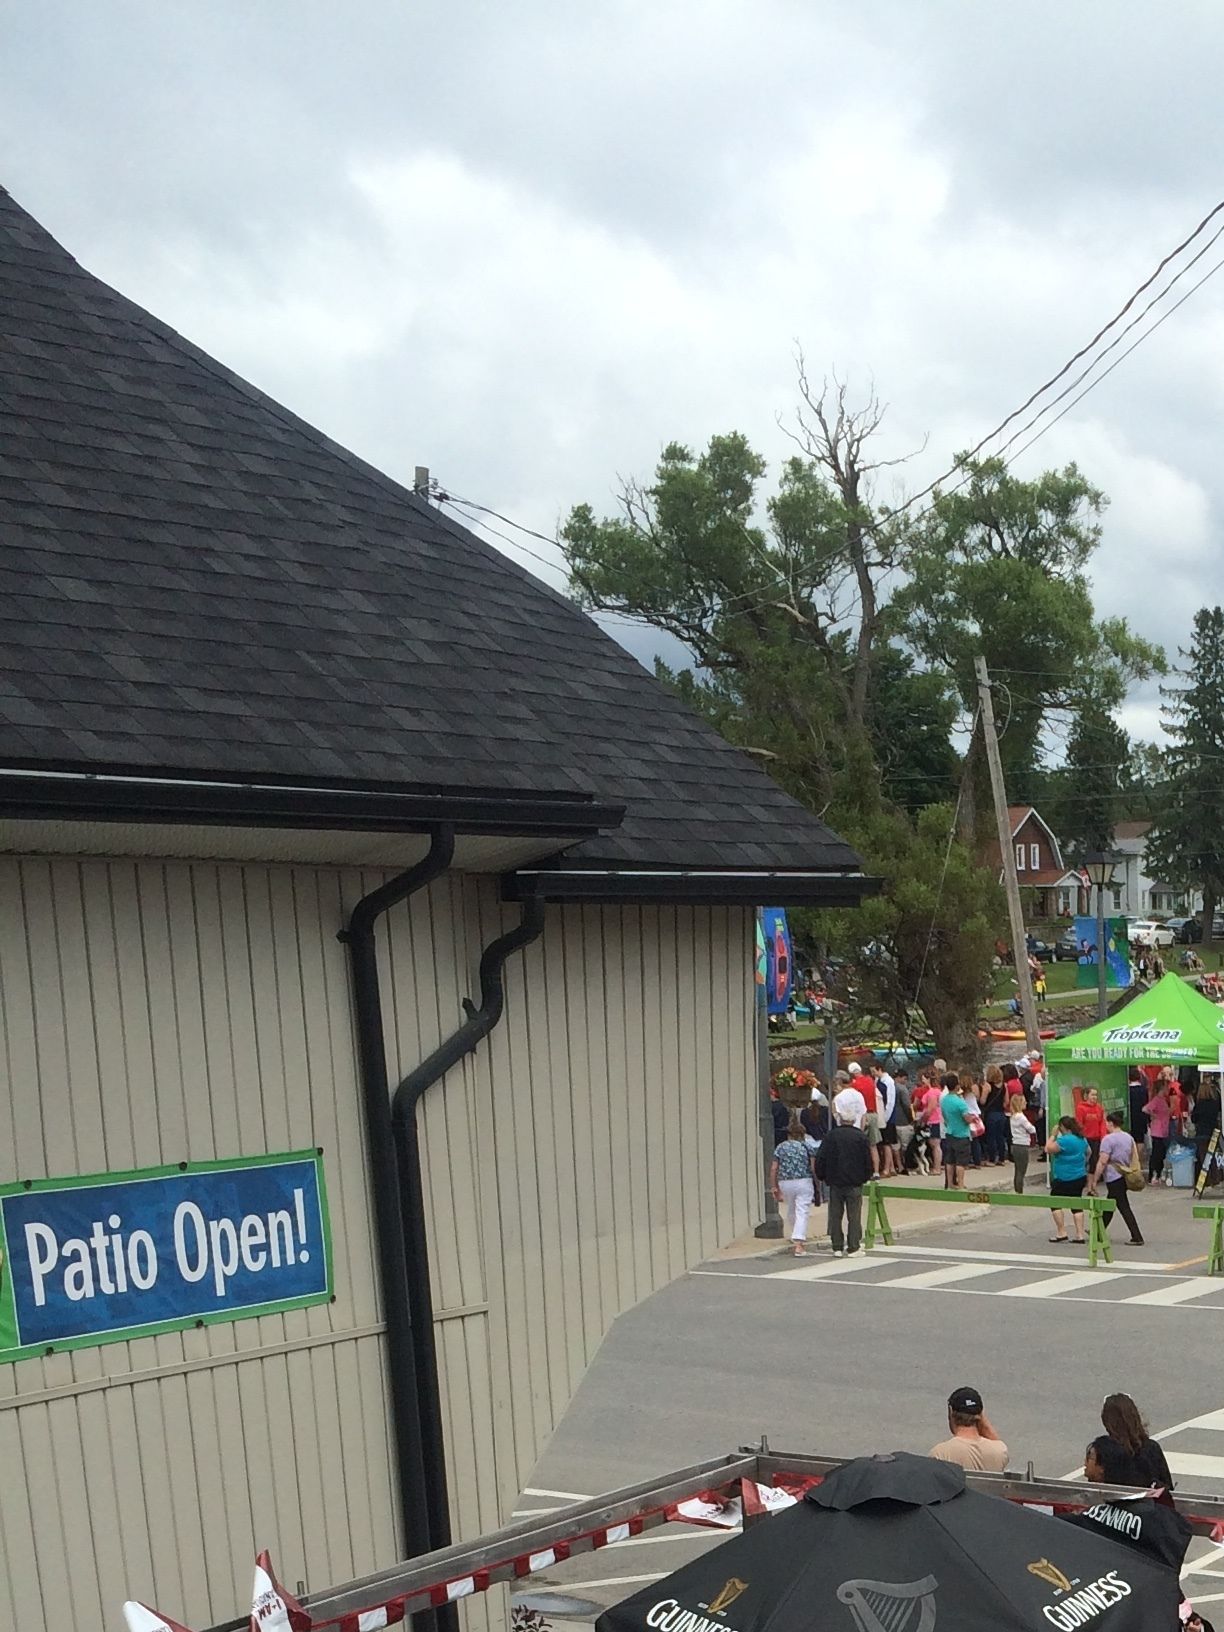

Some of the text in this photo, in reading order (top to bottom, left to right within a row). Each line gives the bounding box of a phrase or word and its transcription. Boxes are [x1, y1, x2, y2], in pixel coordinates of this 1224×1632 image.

[1088, 1047, 1103, 1059] YOU
[1103, 1047, 1128, 1059] READY
[1129, 1047, 1144, 1059] FOR
[1104, 1027, 1180, 1042] Tropicana
[24, 1188, 310, 1306] Patio Open!
[1042, 1573, 1132, 1632] GUINNESS
